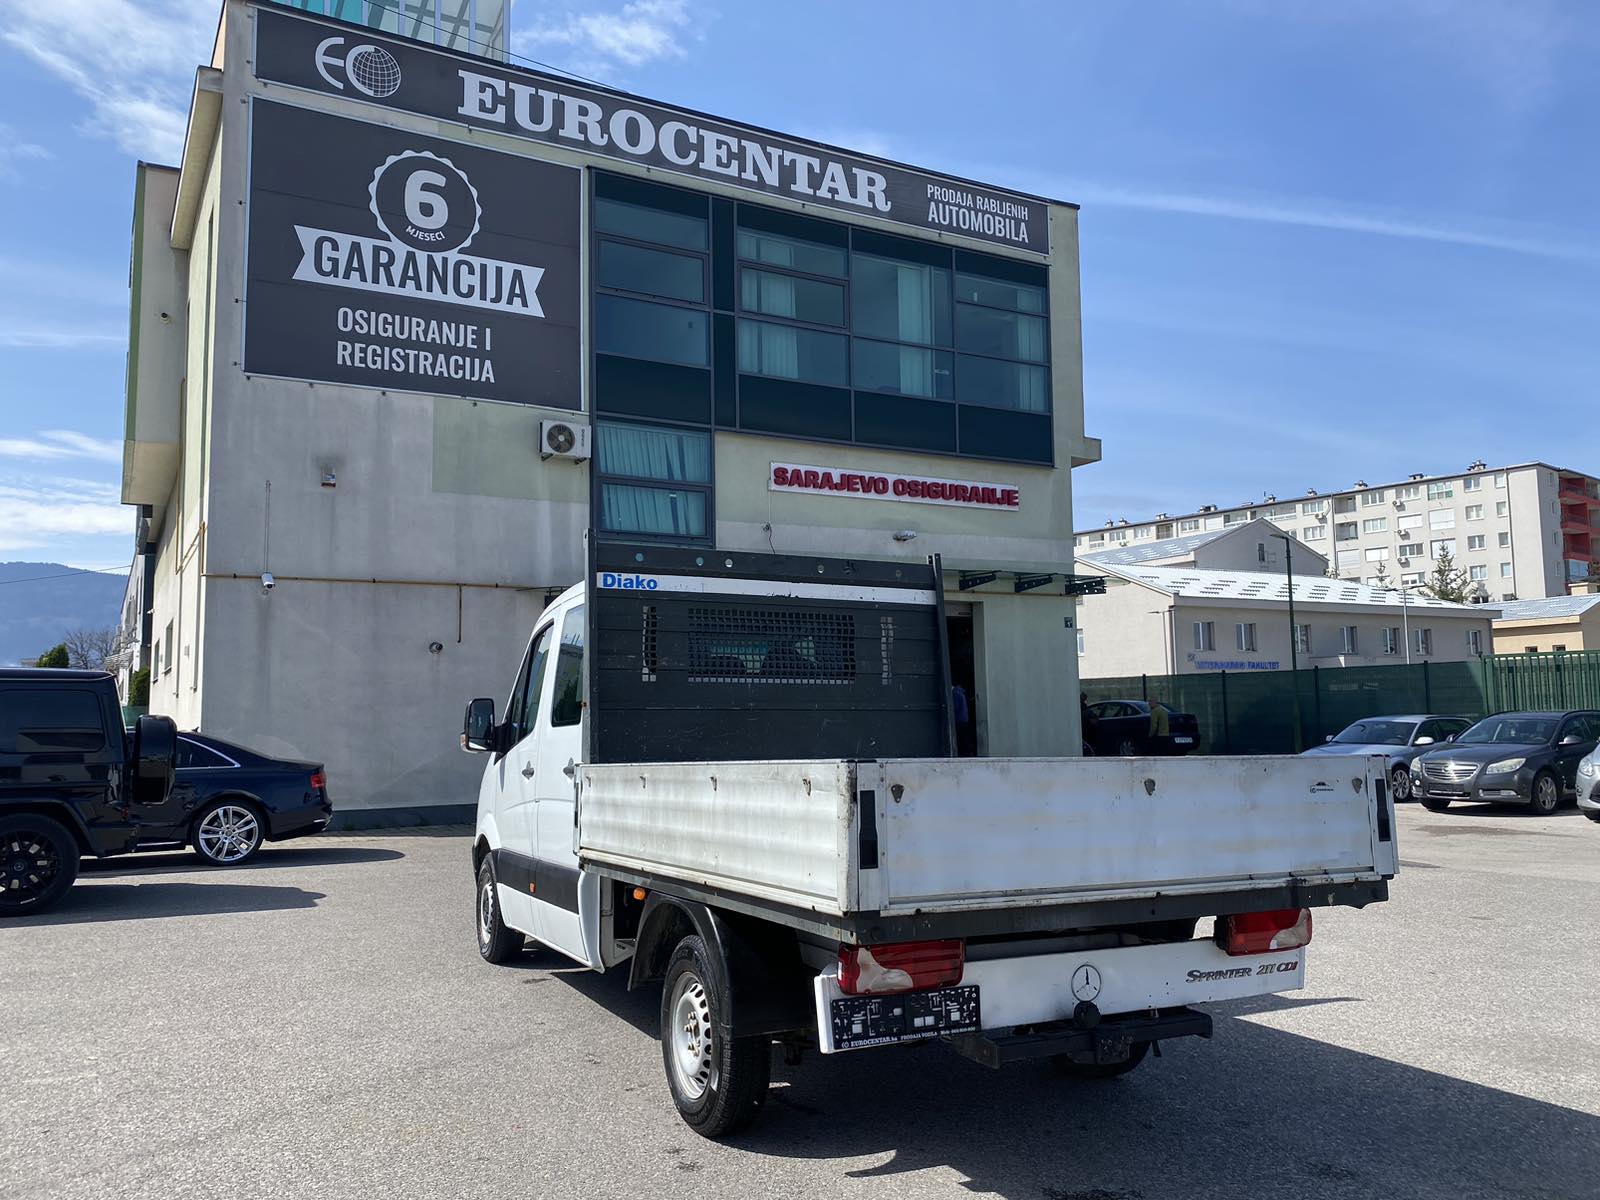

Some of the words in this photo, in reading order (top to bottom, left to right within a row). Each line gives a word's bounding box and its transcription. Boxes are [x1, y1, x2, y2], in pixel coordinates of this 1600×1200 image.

[457, 69, 892, 212] EUROCENTAR
[404, 169, 449, 230] 6
[927, 184, 974, 208] PRODAJA
[976, 196, 1028, 220] RABLJENIH
[405, 225, 446, 242] MJESECI
[928, 201, 1029, 243] AUTOMOBILA
[313, 235, 530, 308] GARANCIJA
[337, 307, 478, 349] OSIGURANJE
[485, 327, 491, 350] I
[337, 340, 495, 384] REGISTRACIJA
[773, 467, 889, 495] SARAJEVO
[893, 478, 1019, 507] OSIGURANJE
[603, 574, 657, 589] Diako
[1276, 961, 1298, 972] CDI
